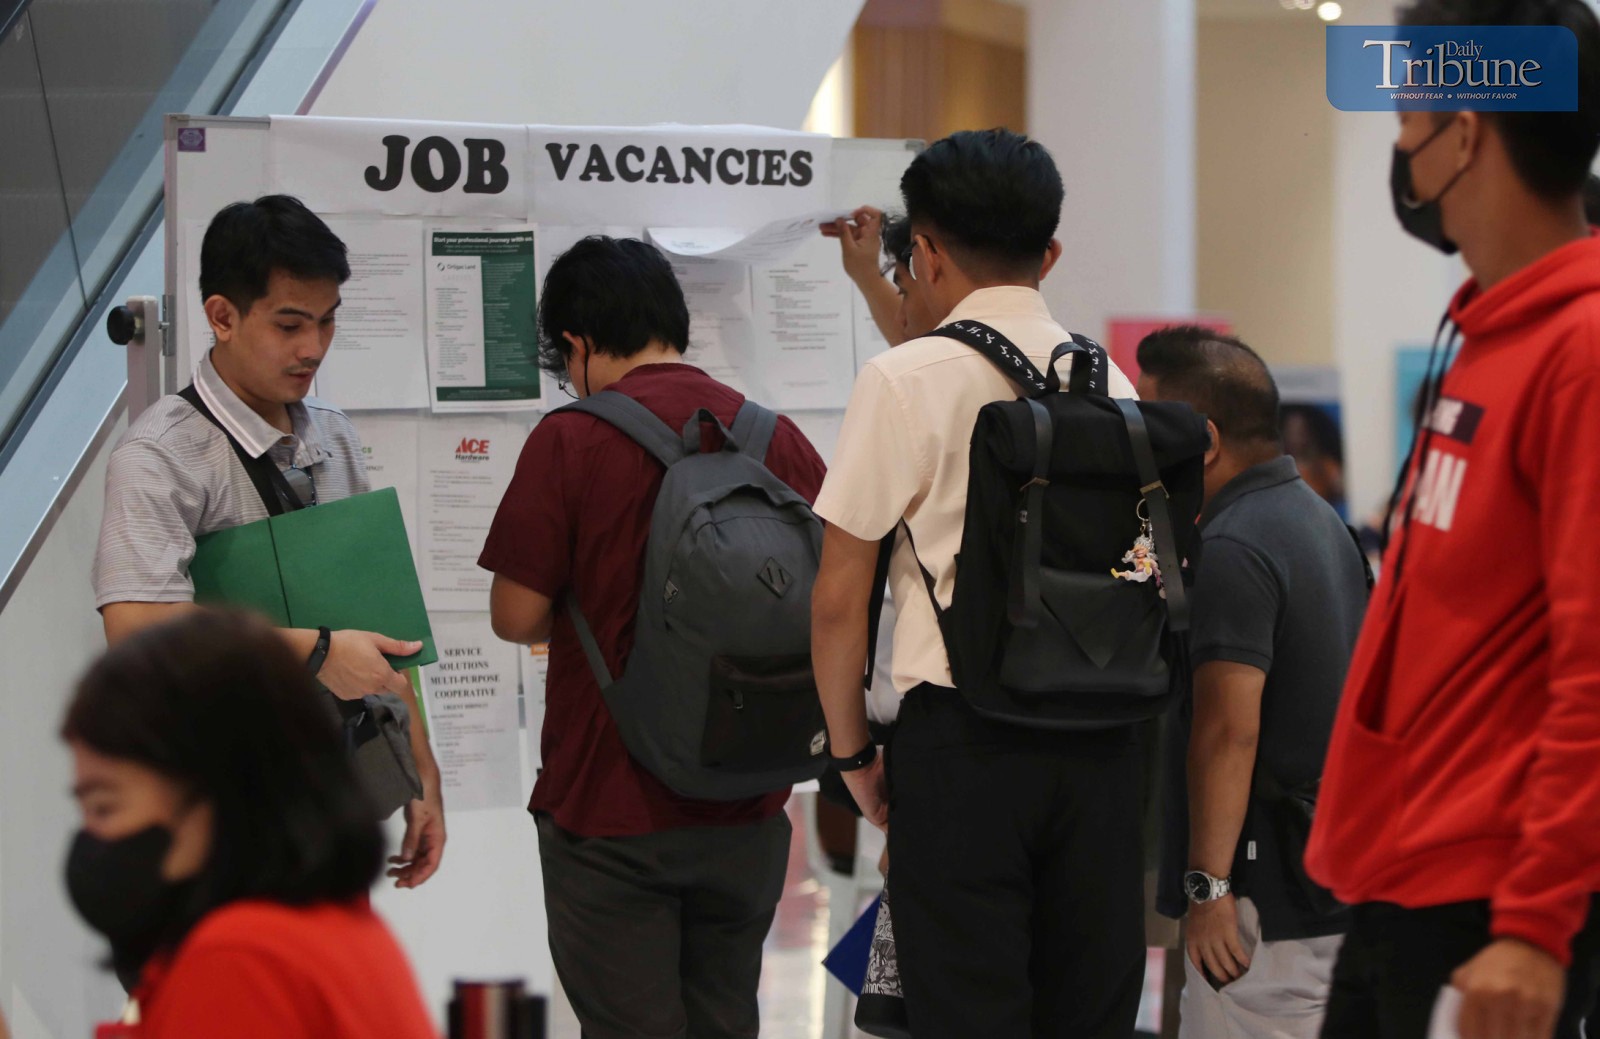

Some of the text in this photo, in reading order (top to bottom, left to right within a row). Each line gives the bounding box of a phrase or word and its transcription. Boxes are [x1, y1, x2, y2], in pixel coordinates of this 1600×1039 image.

[364, 135, 813, 194] JOB VACANCIES
[455, 437, 490, 454] ACE
[444, 647, 482, 657] SERVICE
[439, 661, 489, 670] SOLUTIONS
[430, 674, 500, 685] MULTI-PURPOSE
[434, 687, 496, 699] COOPERATIVE
